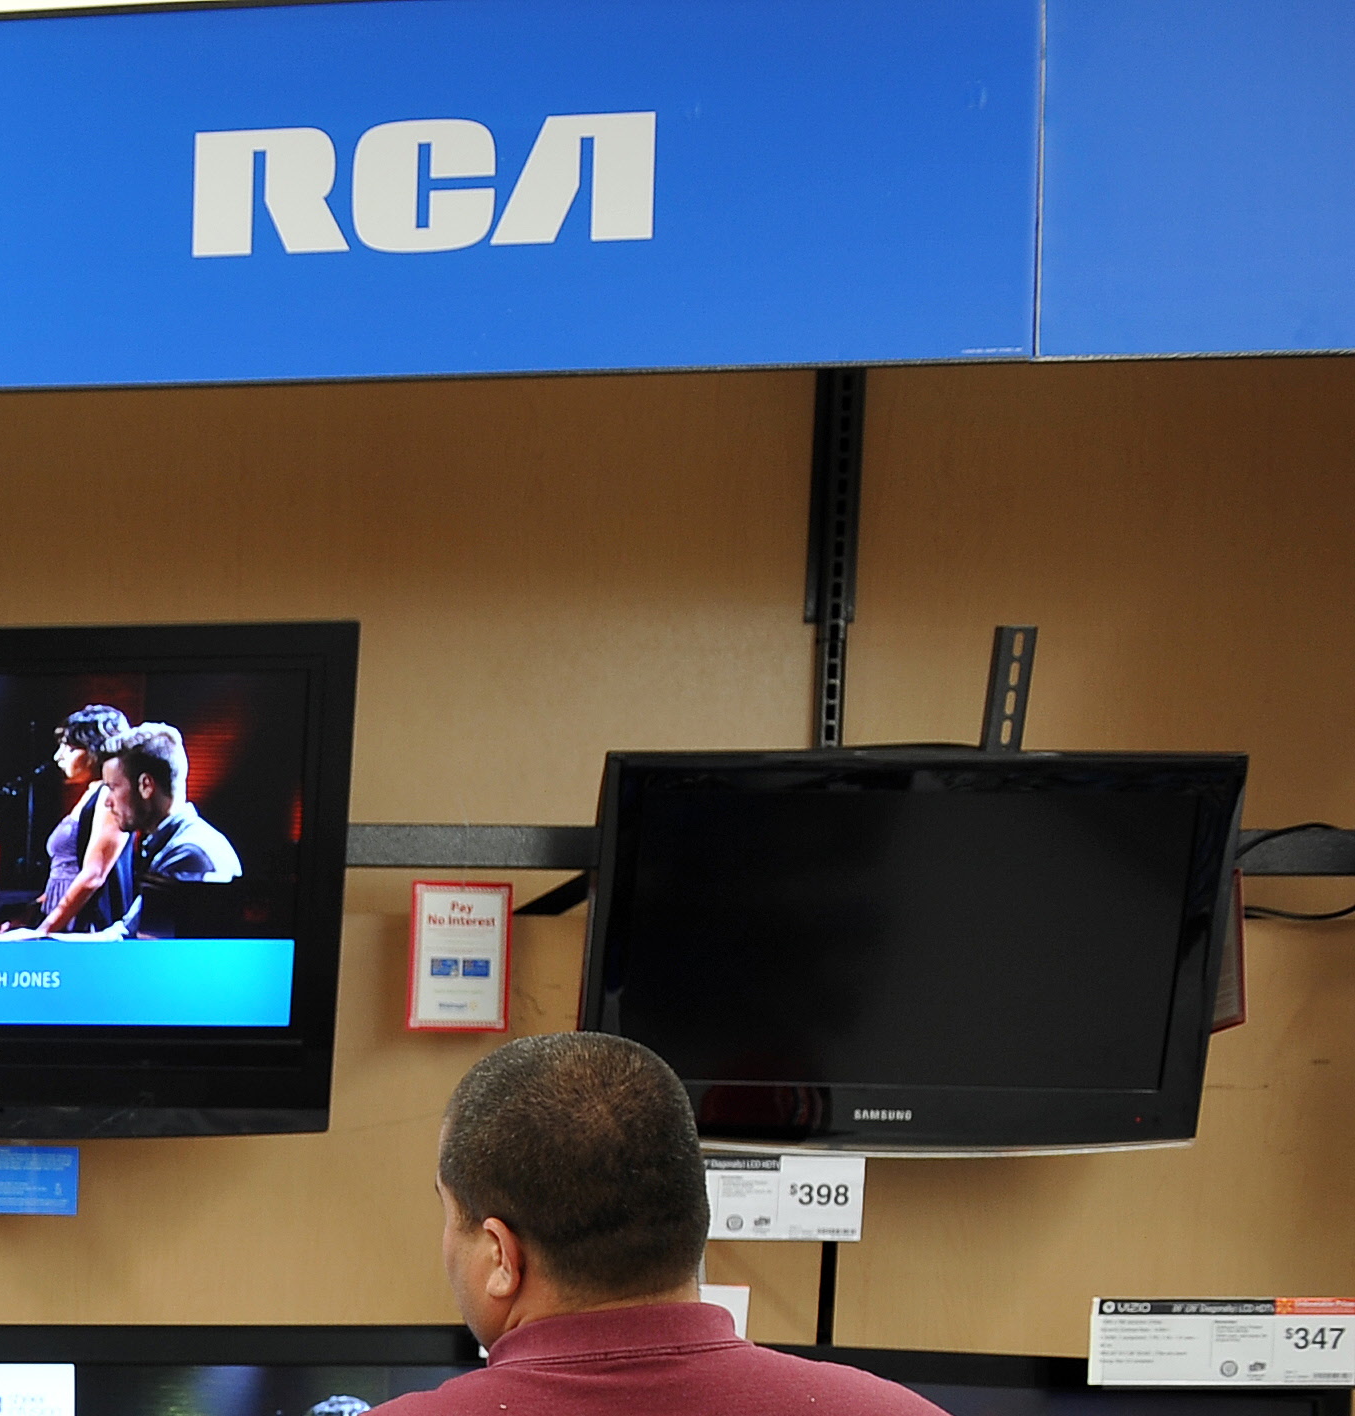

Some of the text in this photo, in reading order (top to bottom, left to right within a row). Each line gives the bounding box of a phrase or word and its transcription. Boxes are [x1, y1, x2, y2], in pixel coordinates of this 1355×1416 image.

[192, 111, 656, 257] RCA
[451, 901, 474, 915] Pay
[428, 915, 496, 926] No Interest
[12, 972, 61, 988] JONES
[854, 1109, 912, 1122] SAMSUNG
[790, 1184, 849, 1206] $398
[1285, 1327, 1347, 1350] $347
